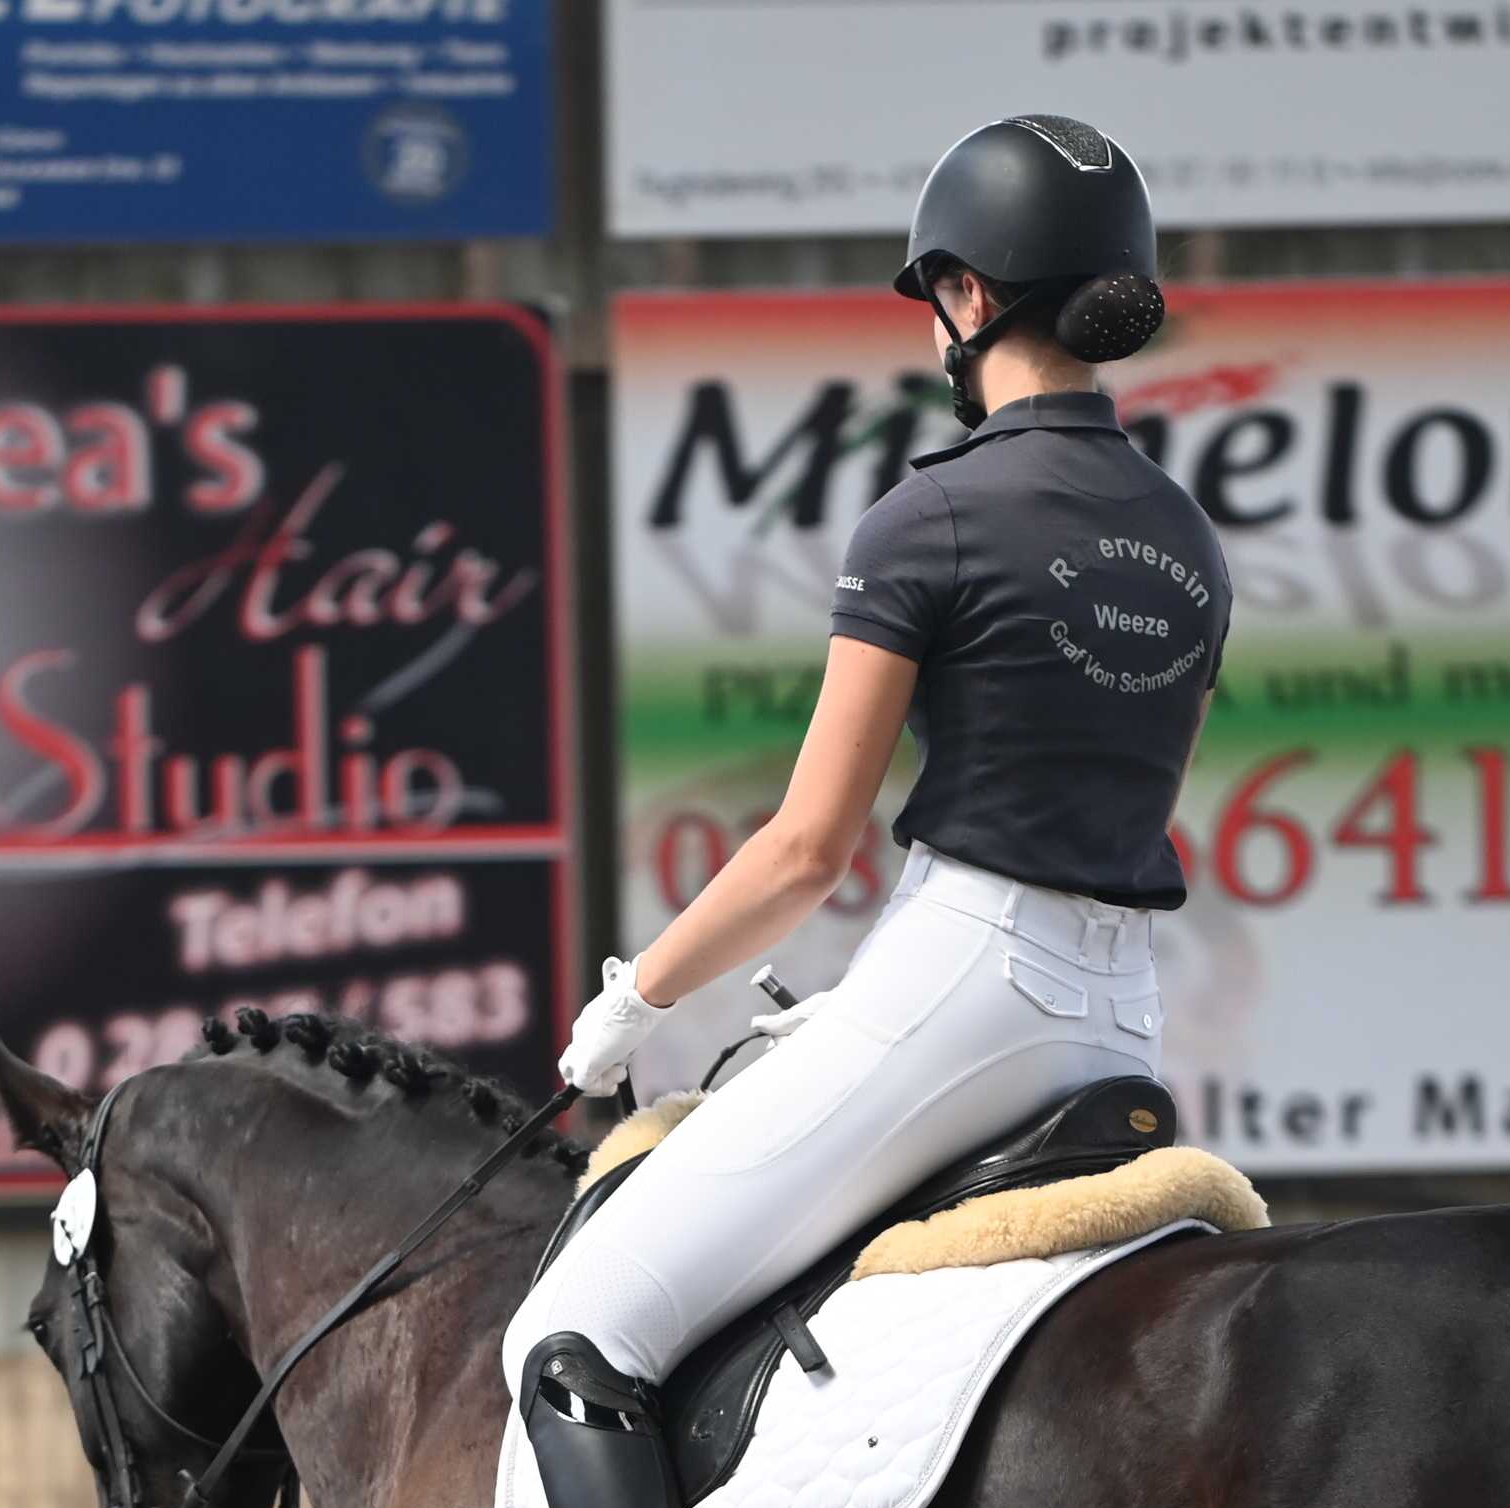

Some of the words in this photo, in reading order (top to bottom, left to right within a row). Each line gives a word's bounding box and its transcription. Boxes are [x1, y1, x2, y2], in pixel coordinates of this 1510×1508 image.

[137, 461, 539, 642] Hair
[1048, 536, 1210, 609] Rerverein
[1049, 619, 1088, 665] Graf
[1083, 653, 1116, 690] Von
[1118, 638, 1206, 694] Schmettow
[1093, 603, 1170, 638] Weeze
[1264, 638, 1411, 707] und
[169, 866, 465, 974] Telefon
[380, 960, 528, 1048] 583
[1175, 1074, 1372, 1146] lter
